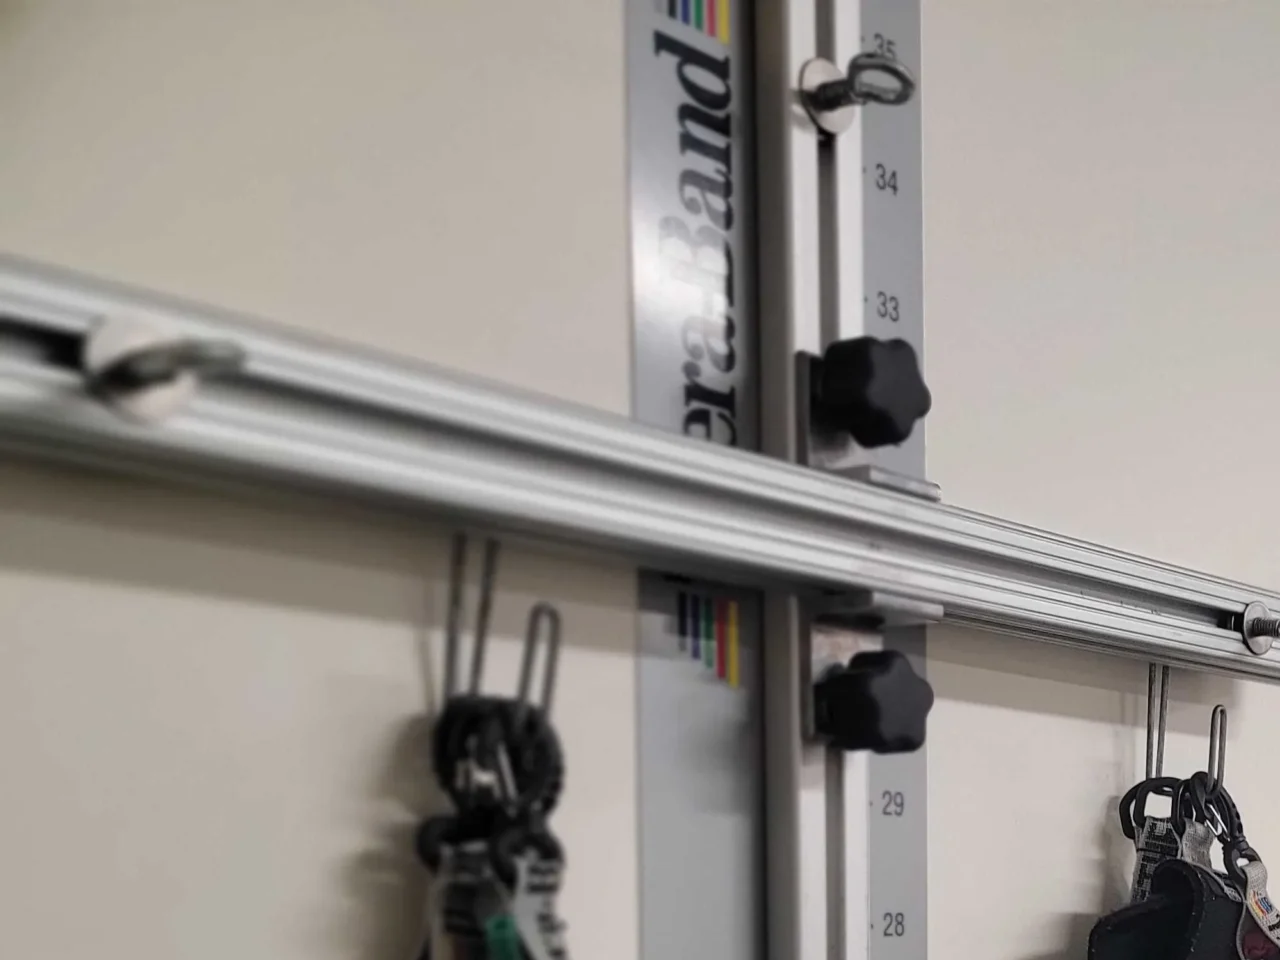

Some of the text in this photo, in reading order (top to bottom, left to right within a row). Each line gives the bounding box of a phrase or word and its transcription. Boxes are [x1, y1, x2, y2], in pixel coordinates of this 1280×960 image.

[875, 163, 898, 196] 34
[876, 291, 900, 322] 33
[881, 790, 904, 816] 29
[883, 912, 904, 937] 28
